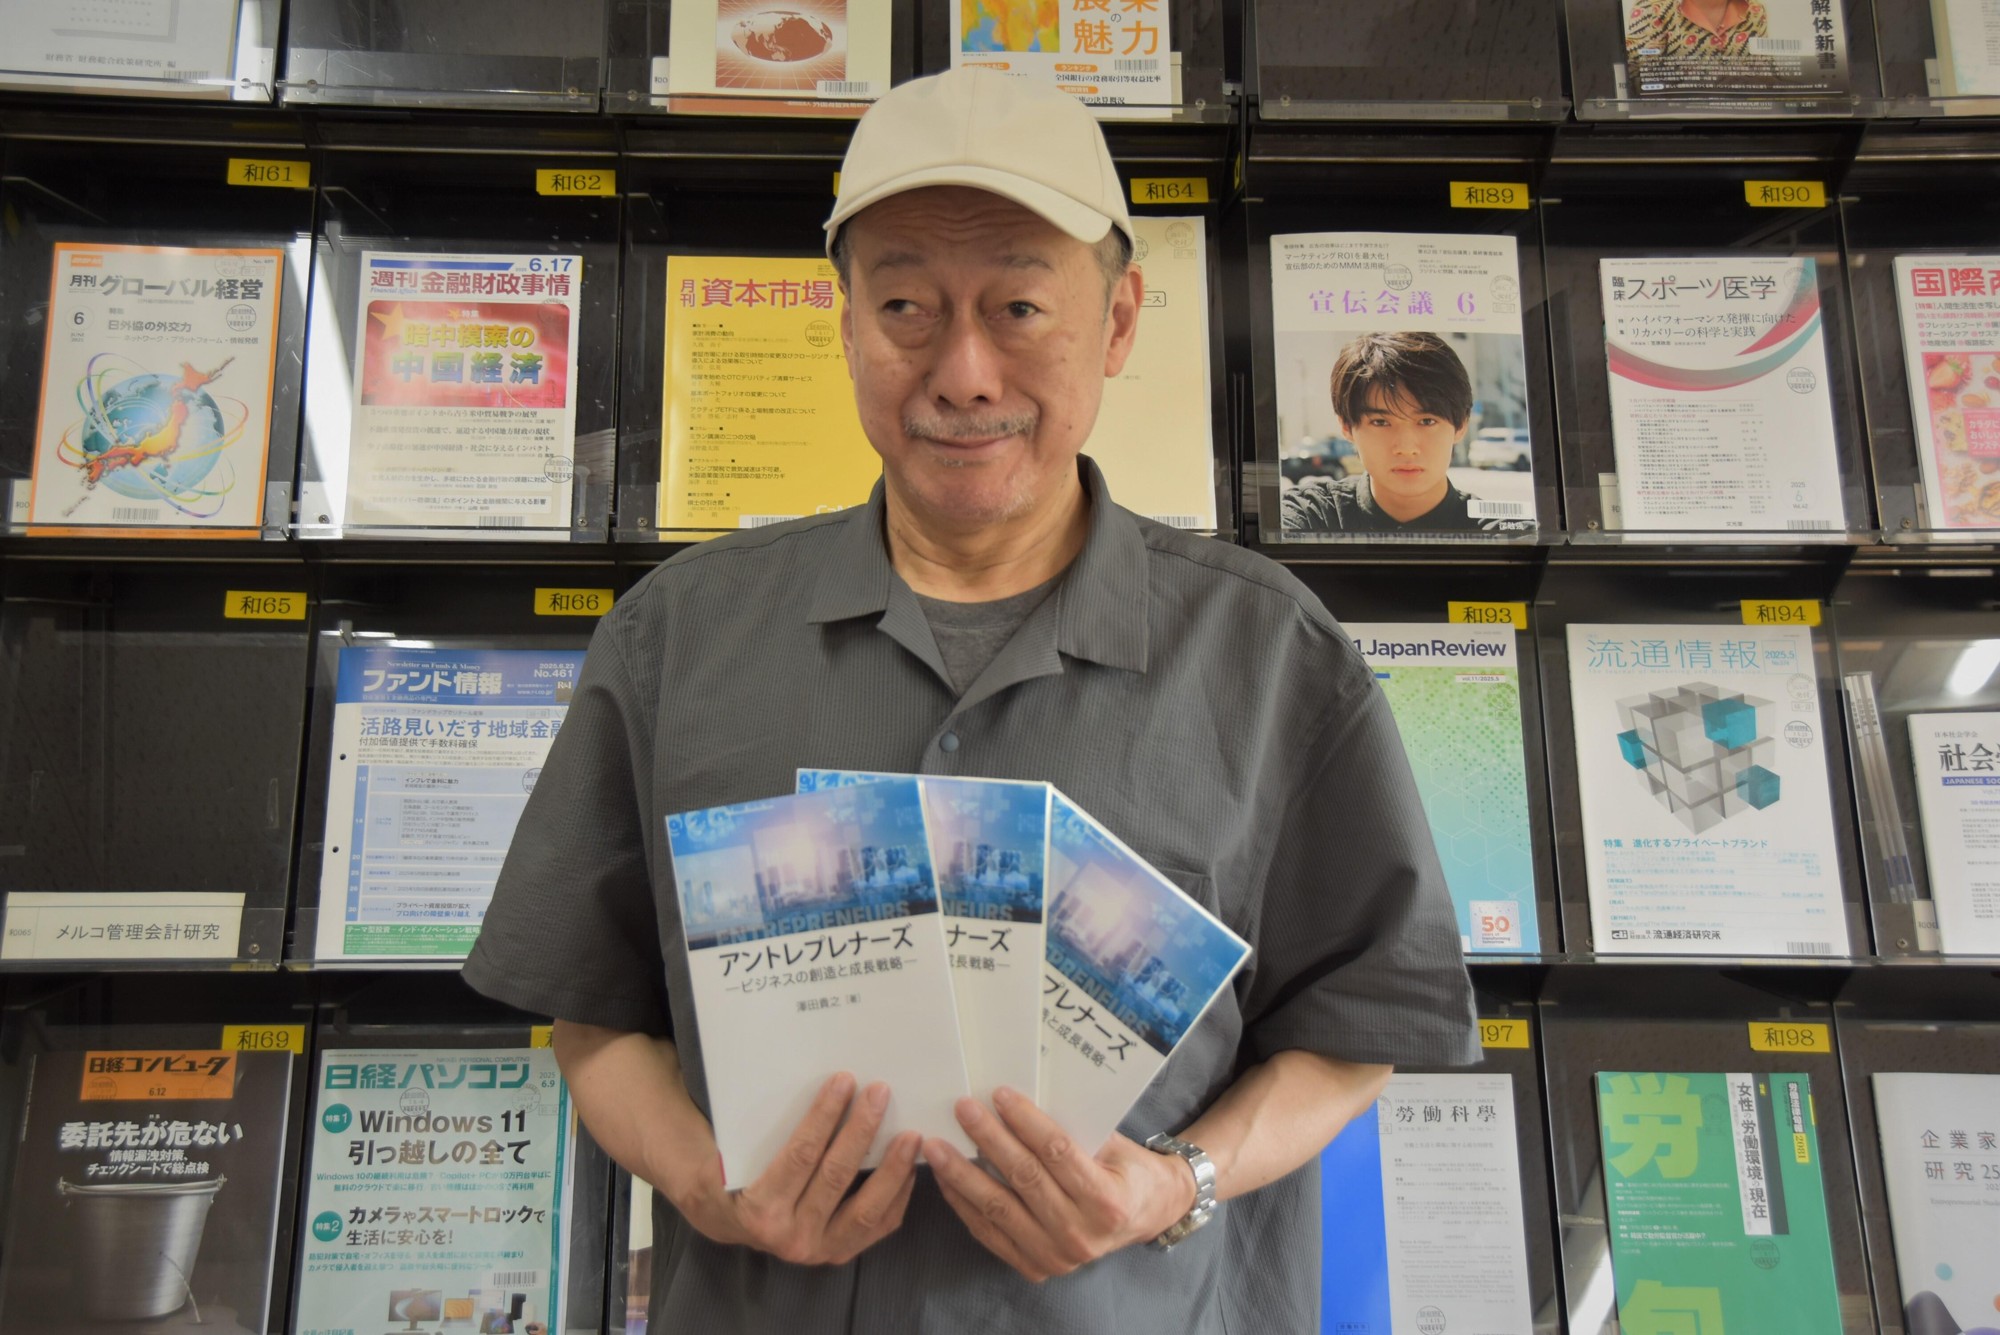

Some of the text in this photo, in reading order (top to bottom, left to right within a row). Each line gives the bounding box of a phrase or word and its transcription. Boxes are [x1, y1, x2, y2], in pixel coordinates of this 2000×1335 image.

[1074, 20, 1158, 55] 魅力
[243, 163, 294, 183] 和61
[551, 173, 602, 191] 和62
[1146, 182, 1194, 200] 和64
[1465, 186, 1515, 204] 和89
[1760, 185, 1810, 203] 和90
[529, 258, 572, 272] 6.17
[70, 275, 263, 300] 月刊 グローバル経営
[371, 270, 570, 296] 週刊 金融財政事情
[1612, 276, 1777, 301] 臨床 スポーツ医学
[680, 278, 834, 309] 月刊 資本市場
[1308, 290, 1475, 315] 宣伝会議 6
[74, 312, 84, 325] 6
[1630, 312, 1796, 324] ハイパフォーマンス発揮に向けた
[403, 324, 535, 348] 暗中模索の
[1631, 327, 1756, 338] リカバリーの科学と実践
[392, 352, 544, 384] 中国経済
[240, 596, 291, 615] 和65
[549, 592, 599, 611] 和66
[1463, 606, 1512, 623] 和93
[1756, 605, 1806, 622] 和94
[1367, 640, 1429, 659] Japan
[1432, 639, 1506, 656] Review
[1586, 640, 1759, 669] 流通情報
[363, 670, 502, 695] ファンド情報
[534, 669, 573, 678] No.461
[56, 924, 220, 940] メルコ管理会計研究
[1481, 916, 1510, 932] 50
[947, 925, 1011, 951] ナーズ
[1653, 930, 1721, 940] 流通経済研究所
[719, 923, 913, 977] アントレプレナーズ
[237, 1031, 289, 1048] 和69
[1765, 1028, 1814, 1047] 和98
[89, 1054, 231, 1073] 日経コンピュータ
[324, 1064, 529, 1089] 日経パソコン
[541, 1080, 555, 1088] 6.9
[149, 1088, 166, 1096] 6.12
[359, 1110, 526, 1133] Windows 11
[1396, 1105, 1496, 1123] 勞働科學
[61, 1121, 243, 1148] 委託先が危ない
[1600, 1073, 1703, 1178] 労
[1921, 1130, 1998, 1149] 企業家
[348, 1140, 531, 1166] 引っ越しの全て
[1737, 1082, 1767, 1219] 女性の労働環境の現在
[88, 1162, 209, 1175] チェックシートで総点検
[1925, 1161, 1974, 1181] 研究
[348, 1206, 546, 1225] カメラやスマートロックで
